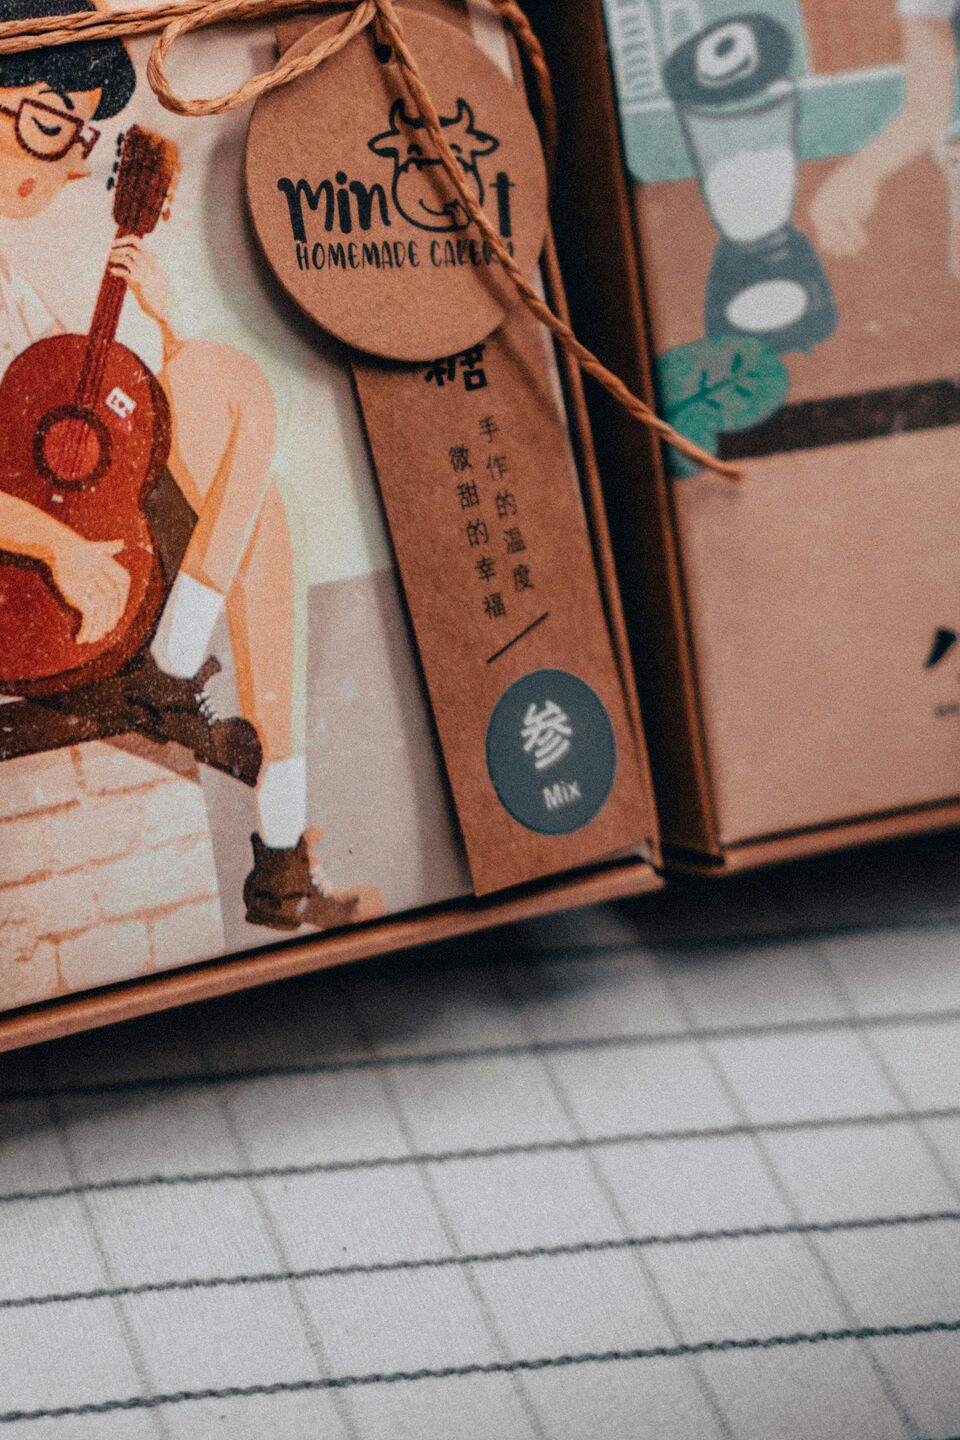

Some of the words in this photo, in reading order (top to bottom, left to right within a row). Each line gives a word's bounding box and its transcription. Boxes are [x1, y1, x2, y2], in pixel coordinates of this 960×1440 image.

[296, 240, 419, 271] HOMEMADE
[479, 415, 535, 593] 手作的温度
[521, 700, 573, 769] 参
[543, 780, 582, 809] Mix
